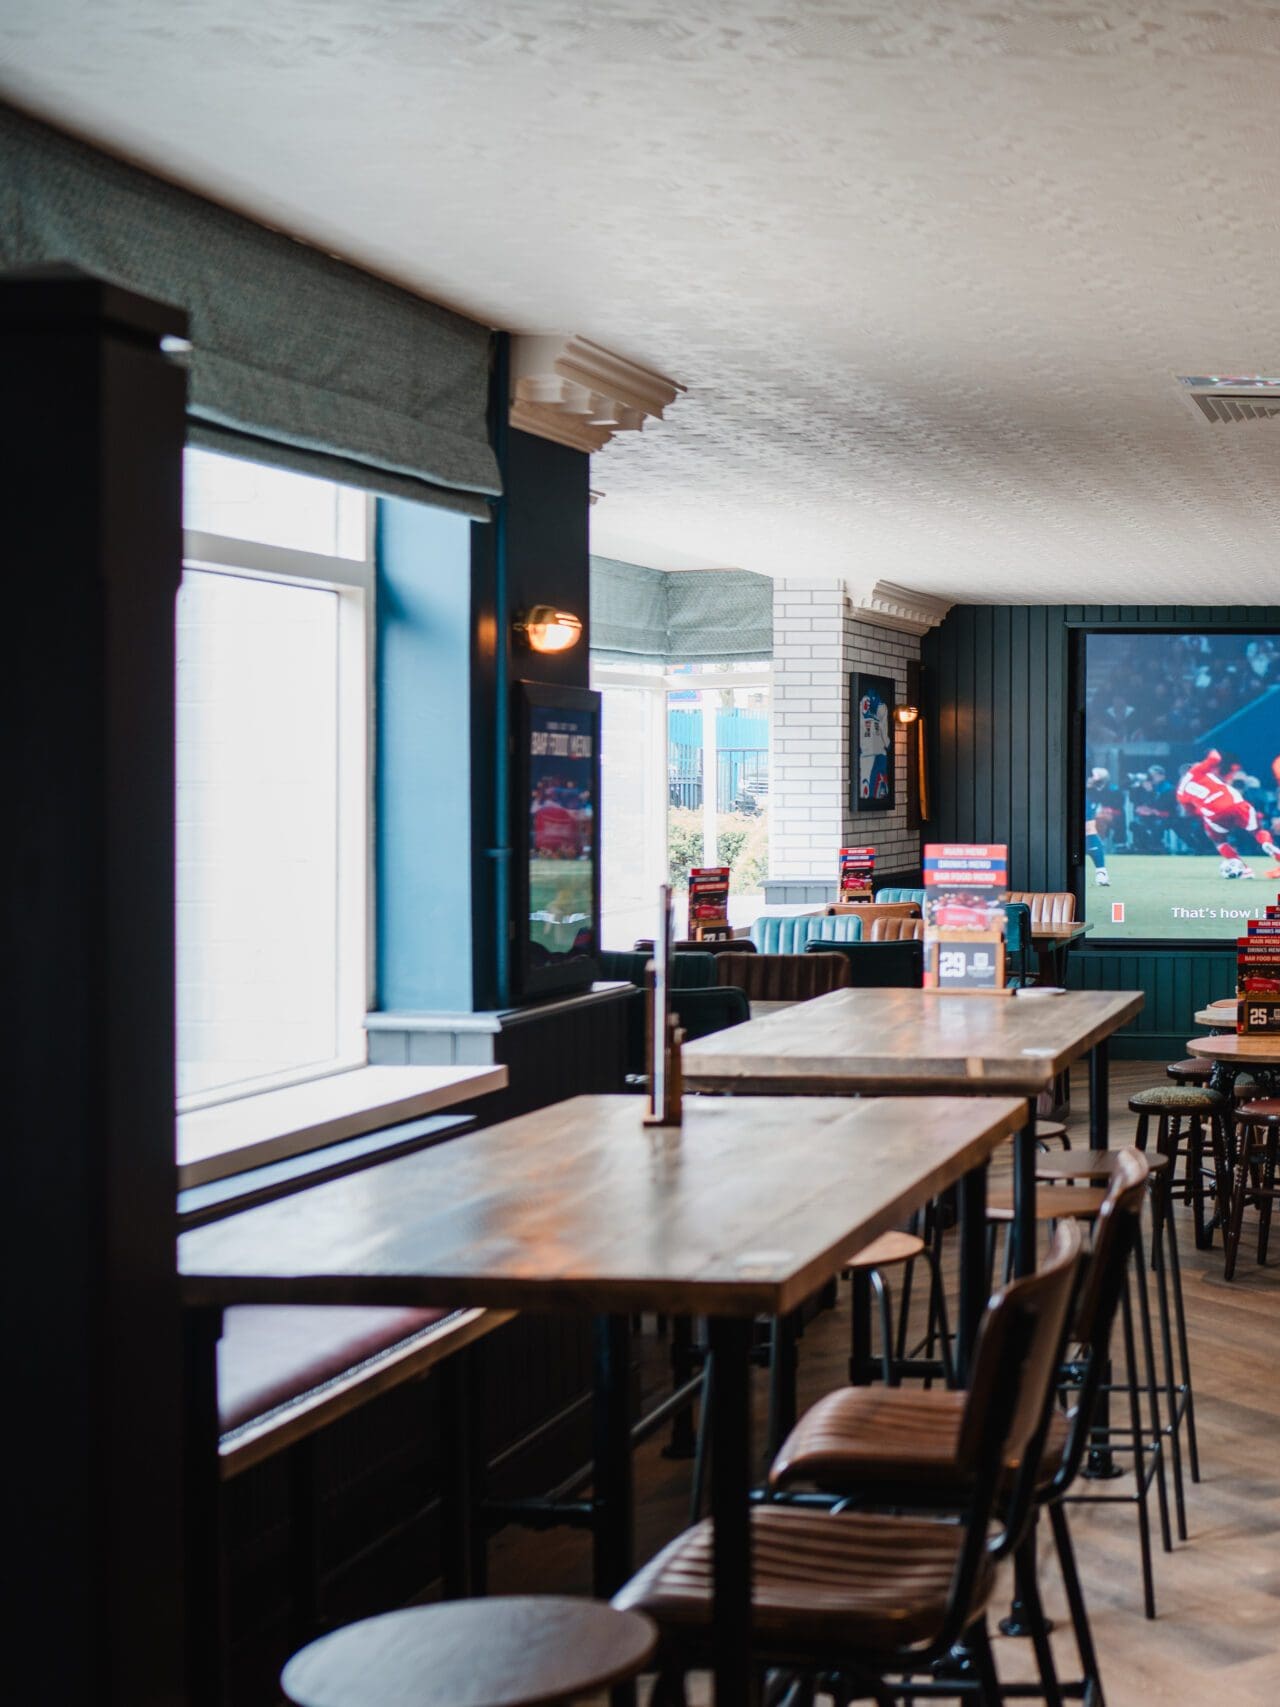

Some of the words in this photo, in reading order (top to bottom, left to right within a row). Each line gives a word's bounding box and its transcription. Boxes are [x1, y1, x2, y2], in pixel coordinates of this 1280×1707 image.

[1171, 907, 1217, 919] That's
[1220, 908, 1251, 919] how
[1255, 908, 1259, 919] I
[1249, 1008, 1267, 1025] 25
